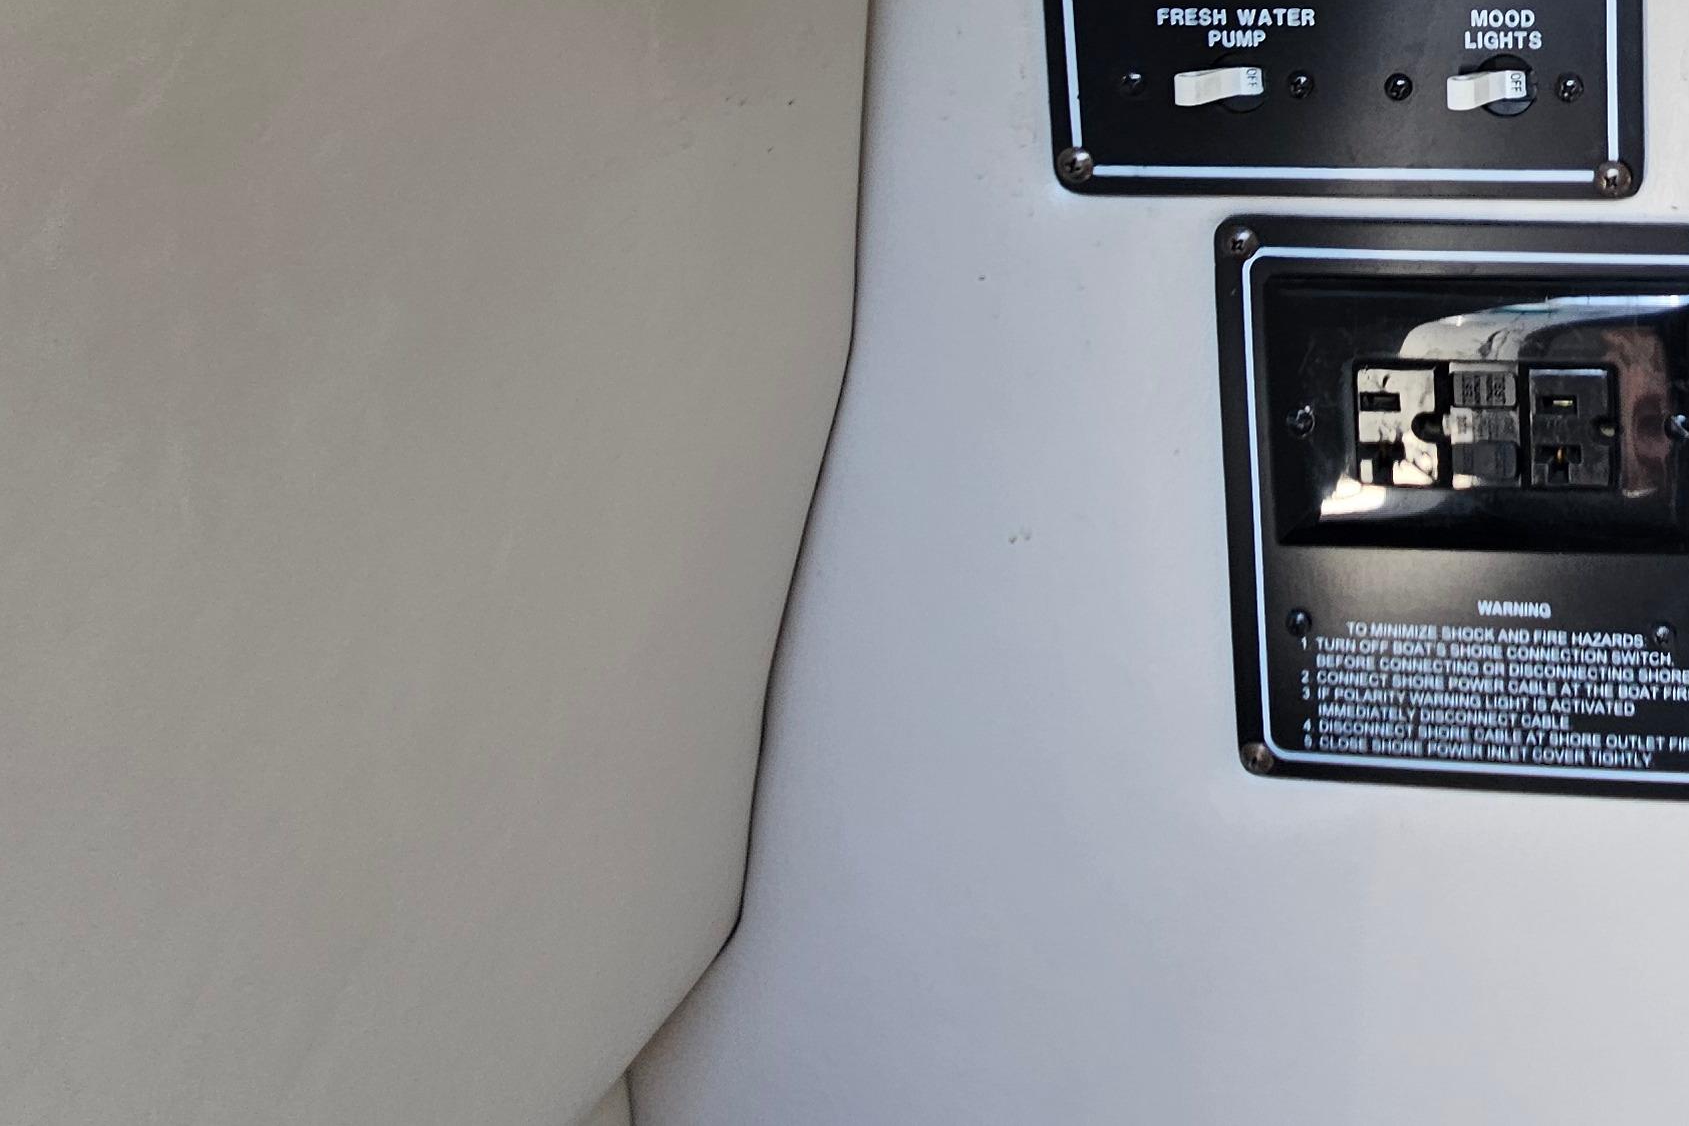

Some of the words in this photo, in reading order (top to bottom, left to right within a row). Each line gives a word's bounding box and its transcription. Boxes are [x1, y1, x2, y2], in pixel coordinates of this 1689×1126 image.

[1157, 8, 1227, 26] FRESH
[1237, 8, 1315, 27] WATER
[1470, 9, 1535, 29] MOOD
[1208, 29, 1266, 48] PUMP
[1464, 31, 1543, 50] LIGHTS
[1246, 68, 1259, 88] OFF
[1510, 73, 1522, 93] OFF
[1477, 599, 1552, 619] WARNING
[1347, 621, 1367, 637] TO
[1370, 622, 1437, 639] MINIMIZE
[1442, 626, 1494, 642] SHOCK
[1498, 628, 1530, 645] AND
[1534, 630, 1567, 645] FIRE
[1301, 637, 1308, 650] 1
[1316, 637, 1356, 653] TURN
[1360, 640, 1388, 654] OFF
[1451, 644, 1503, 659] SHORE
[1507, 646, 1608, 663] CONNECTION
[1316, 654, 1375, 669] BEFORE
[1380, 657, 1479, 675] CONNECTING
[1483, 661, 1505, 676] OR
[1509, 661, 1635, 683] DISCONNECTING
[1301, 671, 1309, 684] 2
[1317, 672, 1387, 688] CONNECT
[1392, 675, 1445, 690] SHORE
[1449, 677, 1504, 692] POWER
[1508, 680, 1558, 695] CABLE
[1561, 683, 1580, 696] AT
[1585, 684, 1614, 698] THE
[1618, 686, 1659, 700] BOAT
[1302, 687, 1310, 700] 3
[1318, 688, 1331, 701] IF
[1335, 689, 1405, 705] POLARITY
[1409, 693, 1482, 709] WARNING
[1486, 697, 1530, 712] LIGHT
[1533, 698, 1547, 712] IS
[1551, 699, 1635, 716] ACTIVATED
[1318, 704, 1416, 721] IMMEDIATELY
[1420, 708, 1517, 725] DISCONNECT
[1303, 719, 1311, 732] 4
[1319, 720, 1413, 737] DISCONNECT
[1418, 725, 1469, 740] SHORE
[1474, 727, 1522, 742] CABLE
[1526, 731, 1546, 746] AT
[1549, 733, 1601, 748] SHORE
[1606, 734, 1665, 750] OUTLET
[1319, 736, 1368, 753] CLOSE
[1372, 739, 1424, 755] SHORE
[1427, 742, 1483, 759] POWER
[1487, 745, 1529, 762] INLET
[1532, 746, 1586, 764] COVER
